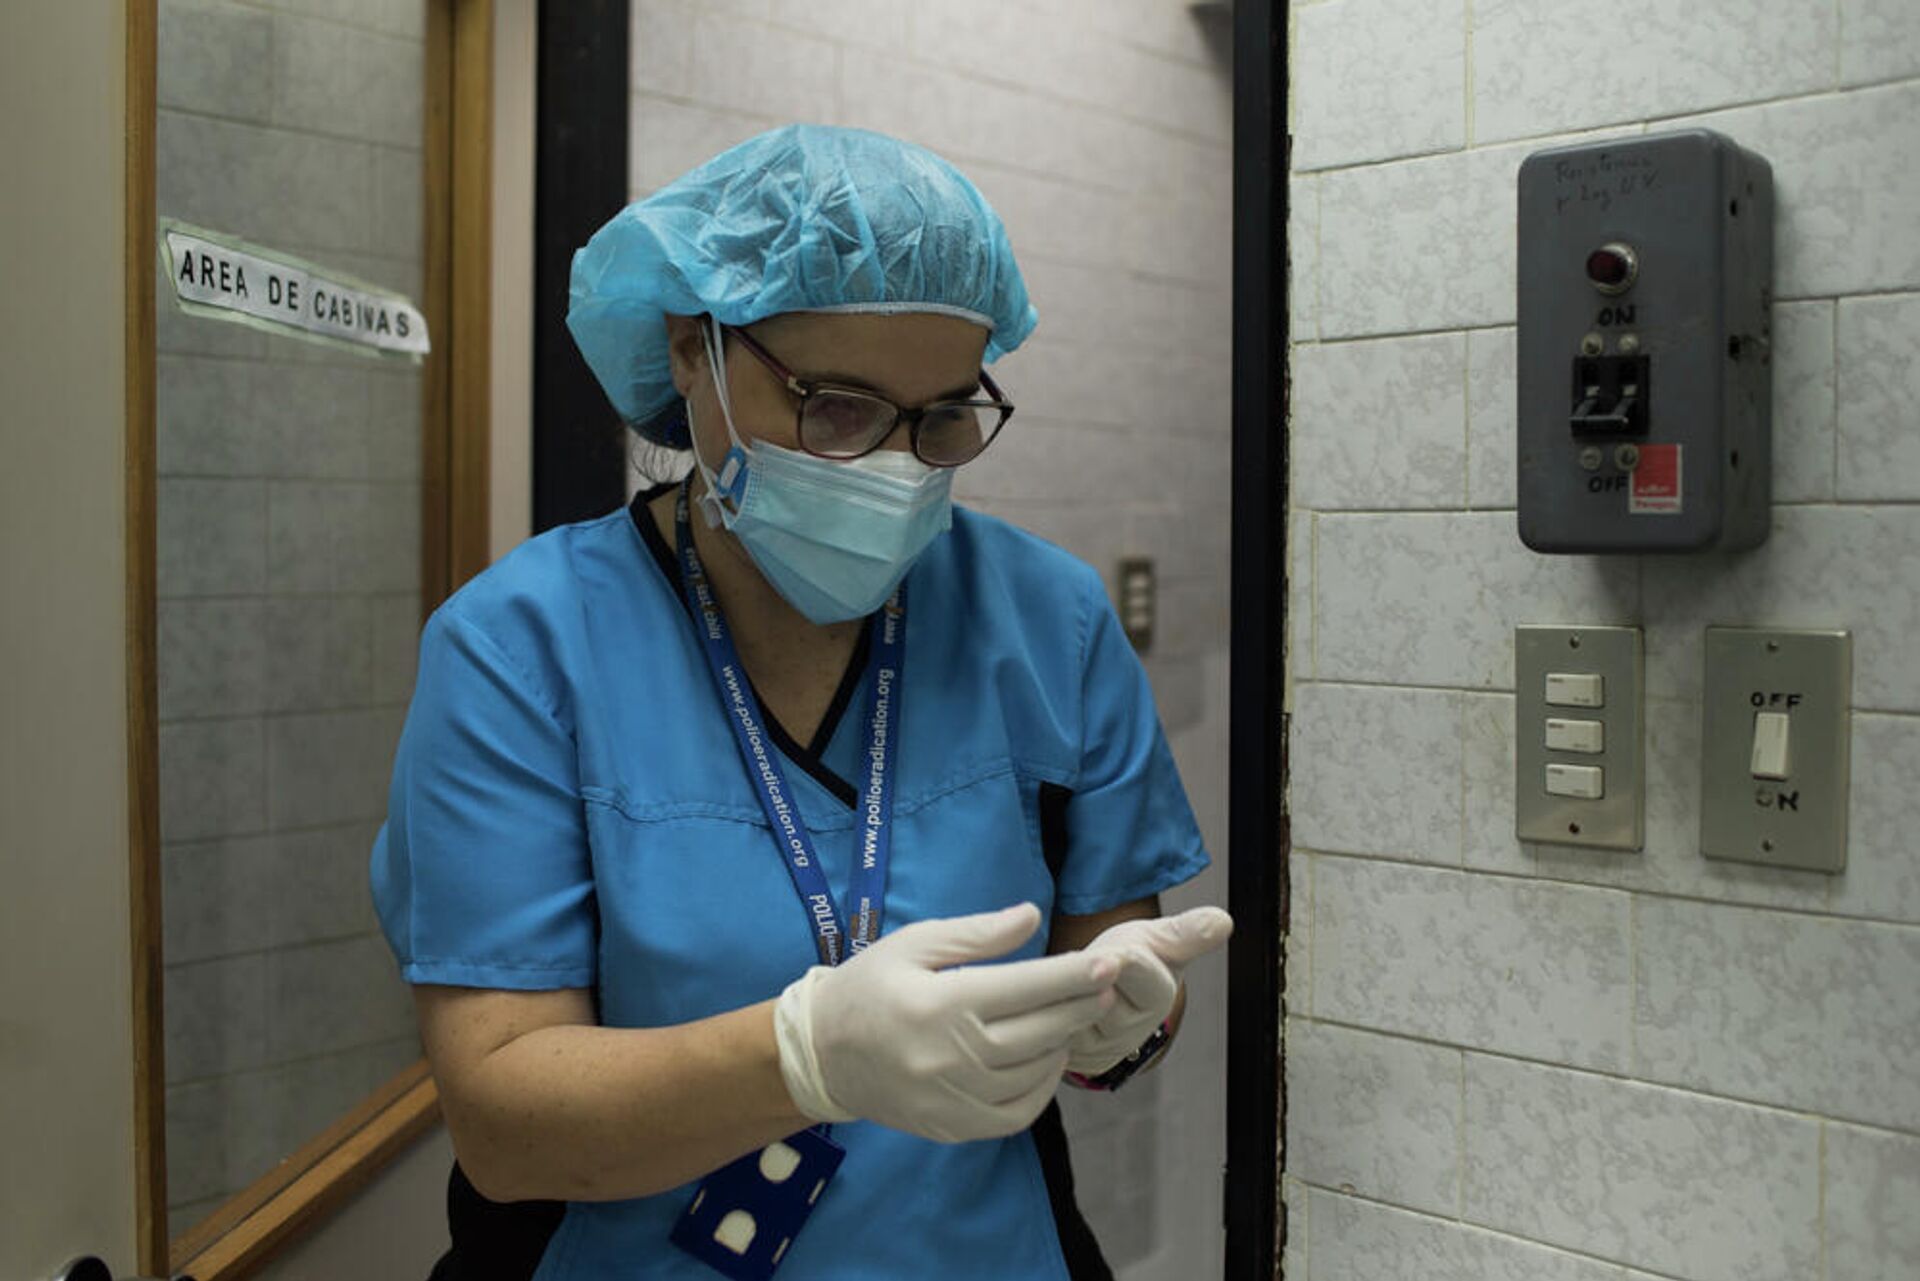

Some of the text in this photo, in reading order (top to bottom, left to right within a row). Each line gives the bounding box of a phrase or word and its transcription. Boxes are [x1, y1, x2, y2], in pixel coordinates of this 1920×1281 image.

[179, 250, 410, 338] AREA DE CABINAS
[1597, 304, 1636, 327] ON
[1587, 476, 1629, 493] OFF
[1750, 691, 1802, 708] OFF
[722, 665, 809, 868] www.polioeradication.org
[863, 668, 895, 869] www.polioeradication.org
[1755, 789, 1799, 811] ON
[808, 894, 839, 937] POLIO
